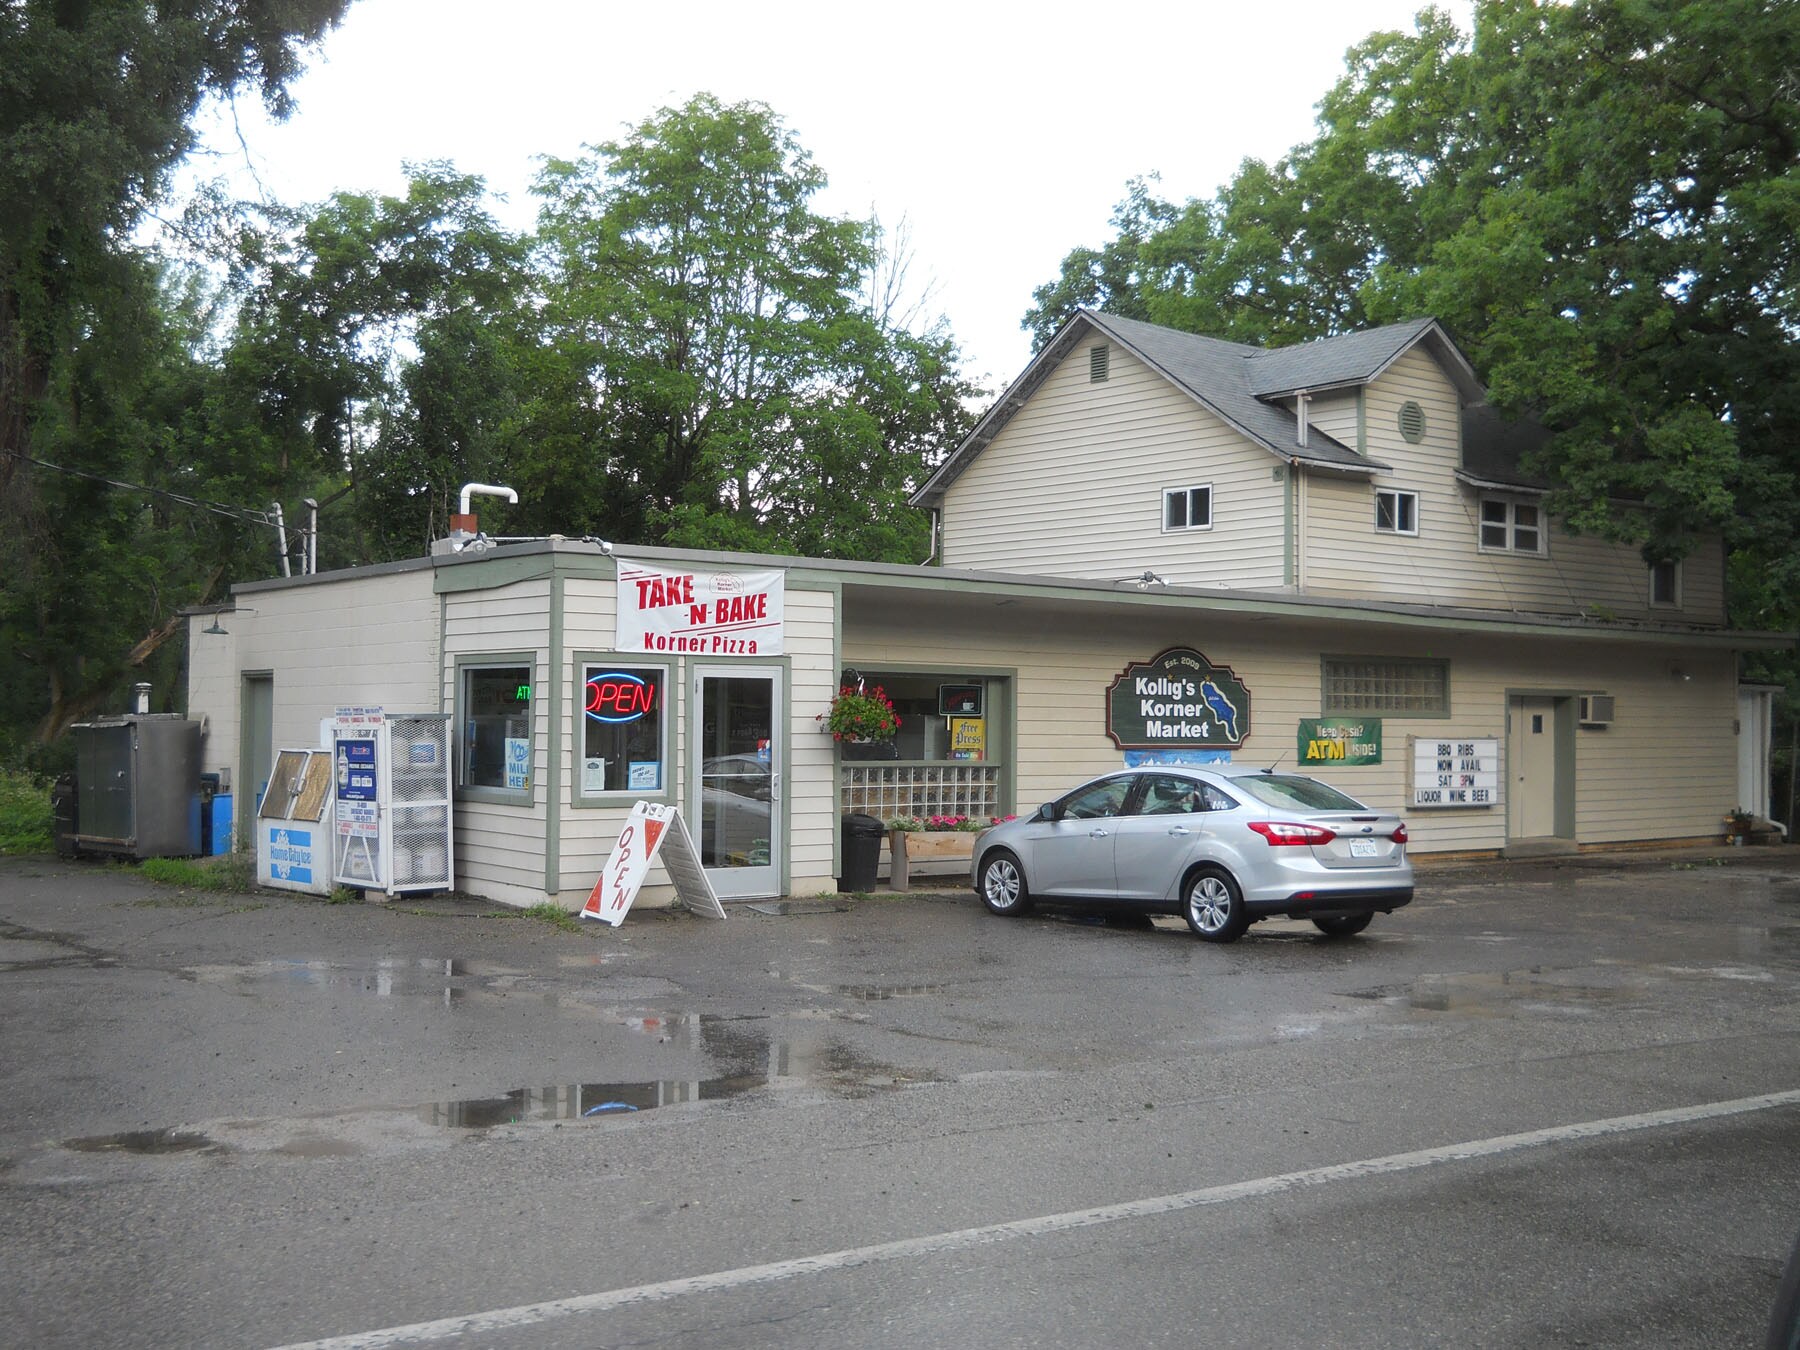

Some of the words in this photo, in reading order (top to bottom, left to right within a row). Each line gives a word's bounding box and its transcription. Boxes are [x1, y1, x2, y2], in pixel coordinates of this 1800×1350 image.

[636, 575, 695, 610] TAKE
[715, 593, 768, 624] BAKE
[644, 632, 707, 652] Korner
[712, 636, 757, 654] Pizza
[1164, 658, 1179, 669] Est.
[1181, 657, 1200, 670] 2009
[585, 682, 655, 713] OPEN
[1135, 678, 1195, 700] Kollig's
[1141, 699, 1203, 717] Korner
[960, 721, 978, 733] Free
[1146, 720, 1209, 738] Market
[956, 732, 981, 746] Press
[1306, 740, 1345, 759] ATM
[1345, 743, 1377, 756] SIDE!
[1458, 744, 1474, 756] RIBS
[1437, 759, 1453, 771] NOW
[1460, 759, 1481, 771] AVAIL
[1438, 774, 1453, 787] SAT
[1460, 774, 1475, 787] 3PM
[1416, 790, 1442, 803] LIQUOR
[1449, 790, 1466, 802] WINE
[1472, 789, 1489, 802] BEER
[270, 845, 289, 861] Home
[288, 847, 301, 866] City
[301, 850, 311, 864] Ice
[611, 825, 635, 911] OPEN
